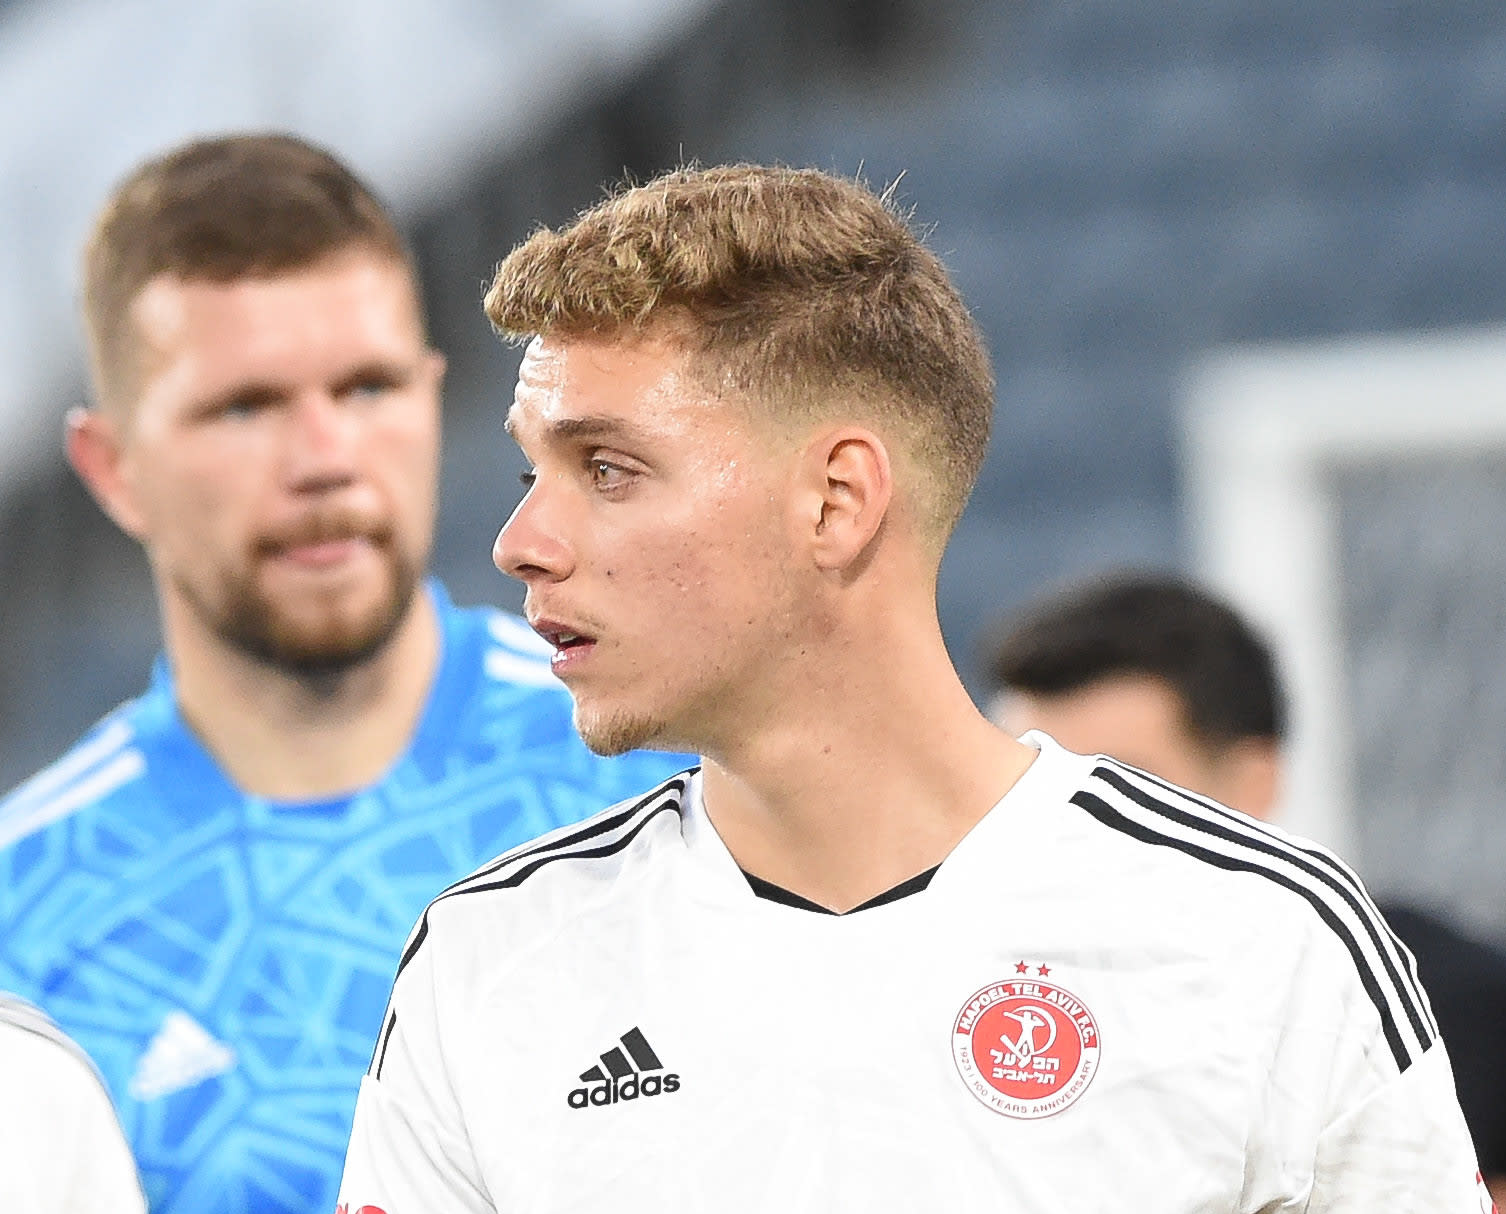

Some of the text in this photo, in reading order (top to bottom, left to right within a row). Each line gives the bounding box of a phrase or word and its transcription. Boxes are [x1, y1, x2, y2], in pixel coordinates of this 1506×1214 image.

[960, 986, 1010, 1030] HAPOEL
[1012, 983, 1043, 998] TEL
[1049, 990, 1083, 1018] AVIV
[990, 1048, 1060, 1069] הפועל
[567, 1072, 681, 1109] adidas
[990, 1094, 1028, 1114] YEARS
[1032, 1059, 1093, 1113] ANNIVERSARY
